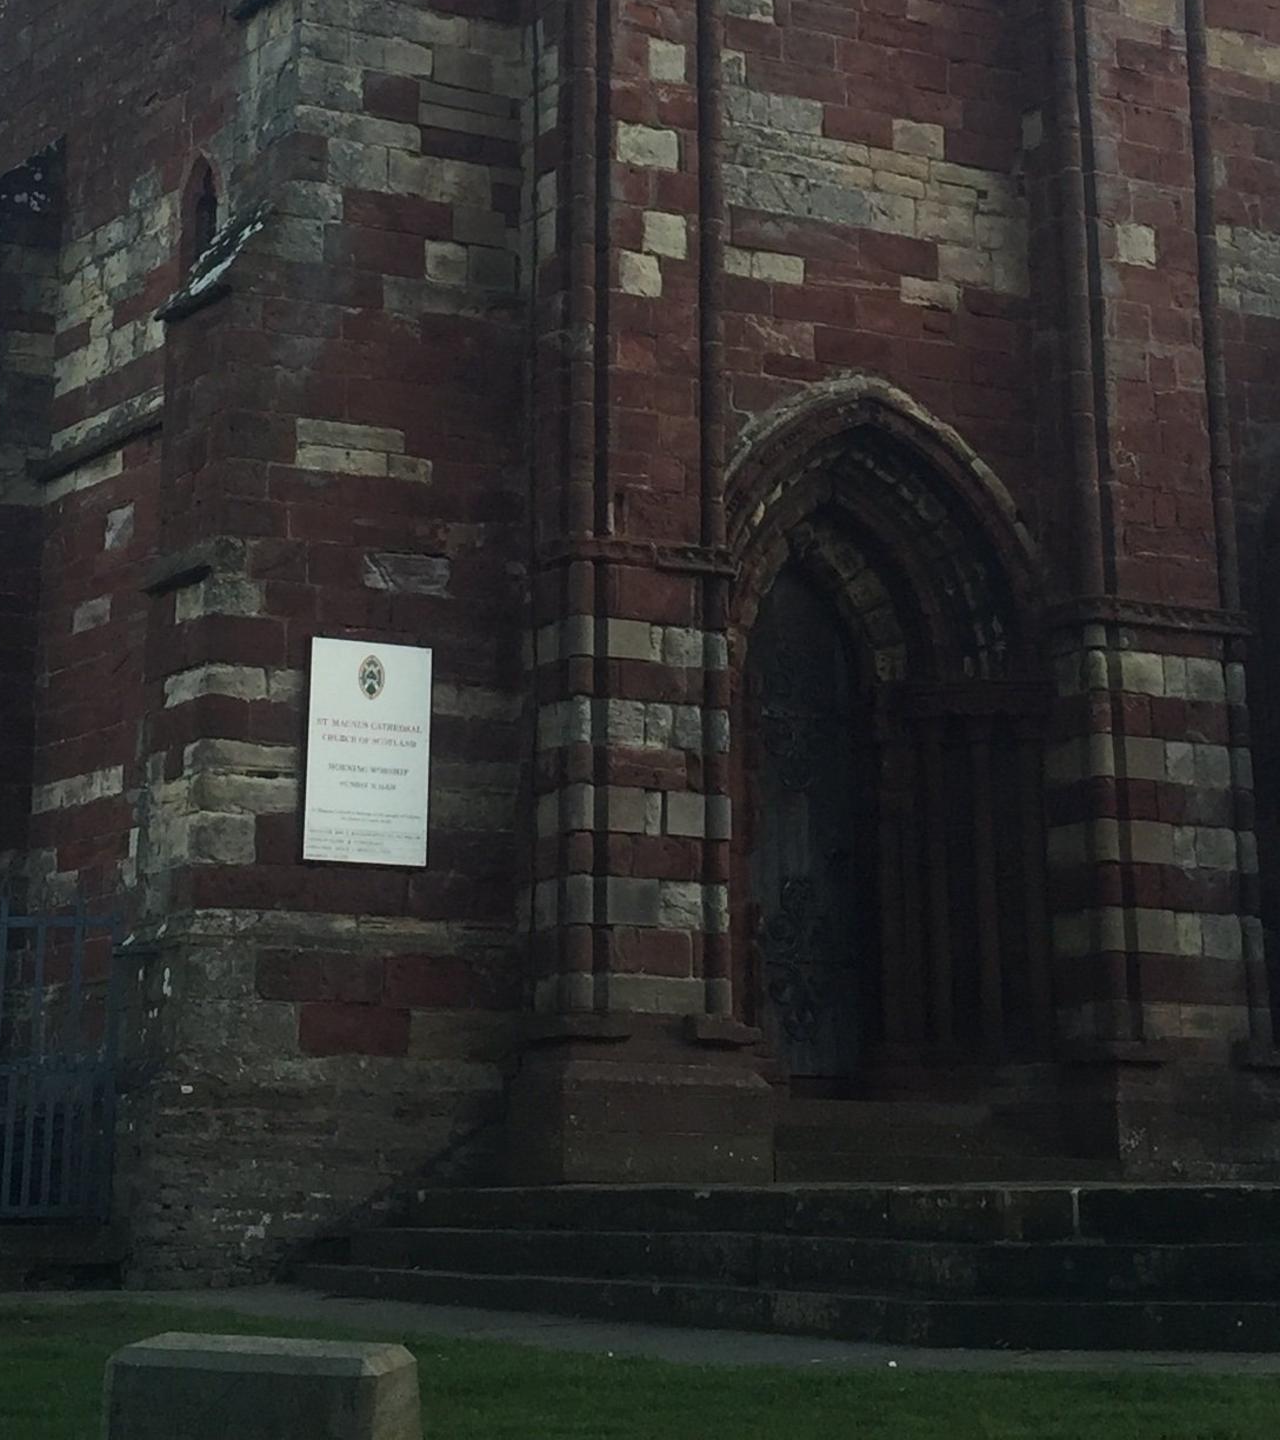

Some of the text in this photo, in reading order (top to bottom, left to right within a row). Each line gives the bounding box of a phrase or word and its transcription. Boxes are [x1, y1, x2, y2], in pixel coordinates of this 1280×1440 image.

[332, 718, 369, 729] MAGNUS
[371, 722, 423, 734] CATHEDRAL
[322, 734, 357, 744] CHURCH
[372, 738, 417, 748] SCOTLAND
